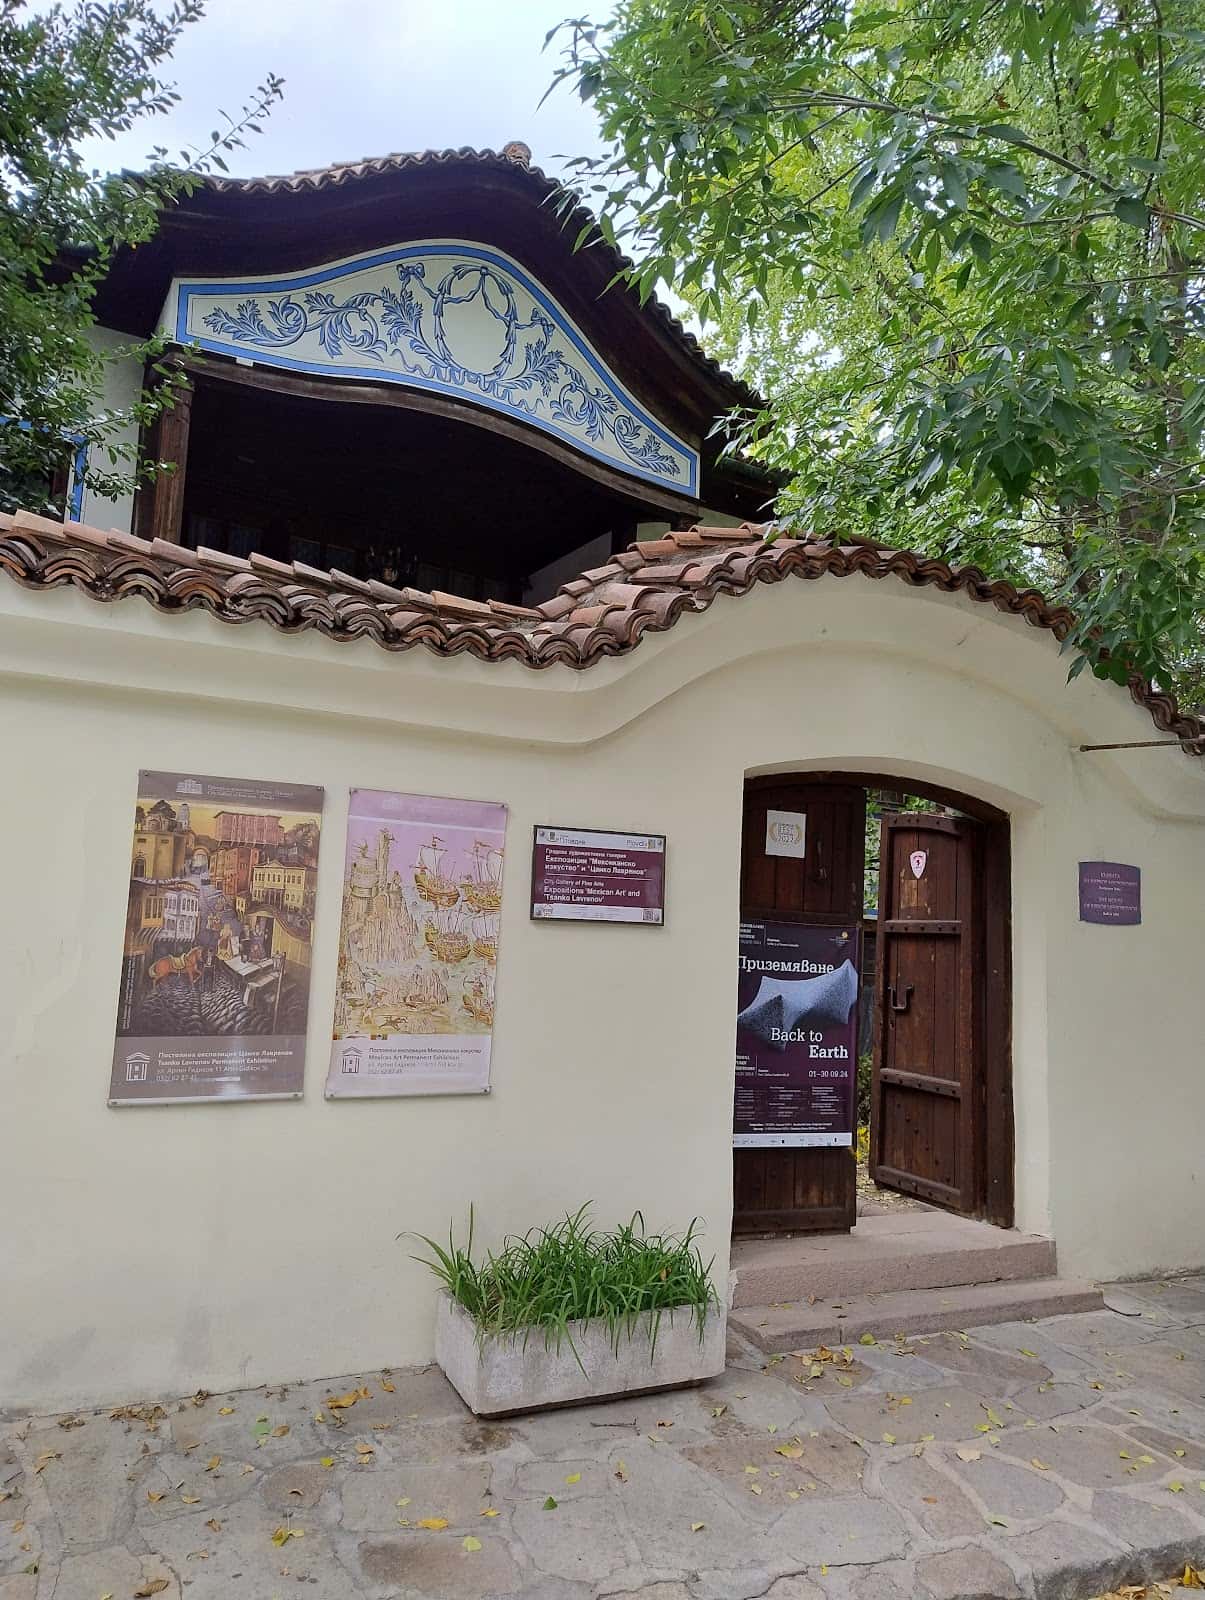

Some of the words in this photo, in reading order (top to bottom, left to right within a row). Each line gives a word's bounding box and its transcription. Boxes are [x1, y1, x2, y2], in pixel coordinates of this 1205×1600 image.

[545, 855, 588, 865] Експозиции
[555, 879, 574, 887] Gallery
[543, 886, 584, 896] Expositions
[737, 956, 834, 974] Приземяване
[771, 1027, 805, 1042] Back
[809, 1029, 823, 1042] to
[809, 1044, 849, 1059] Earth
